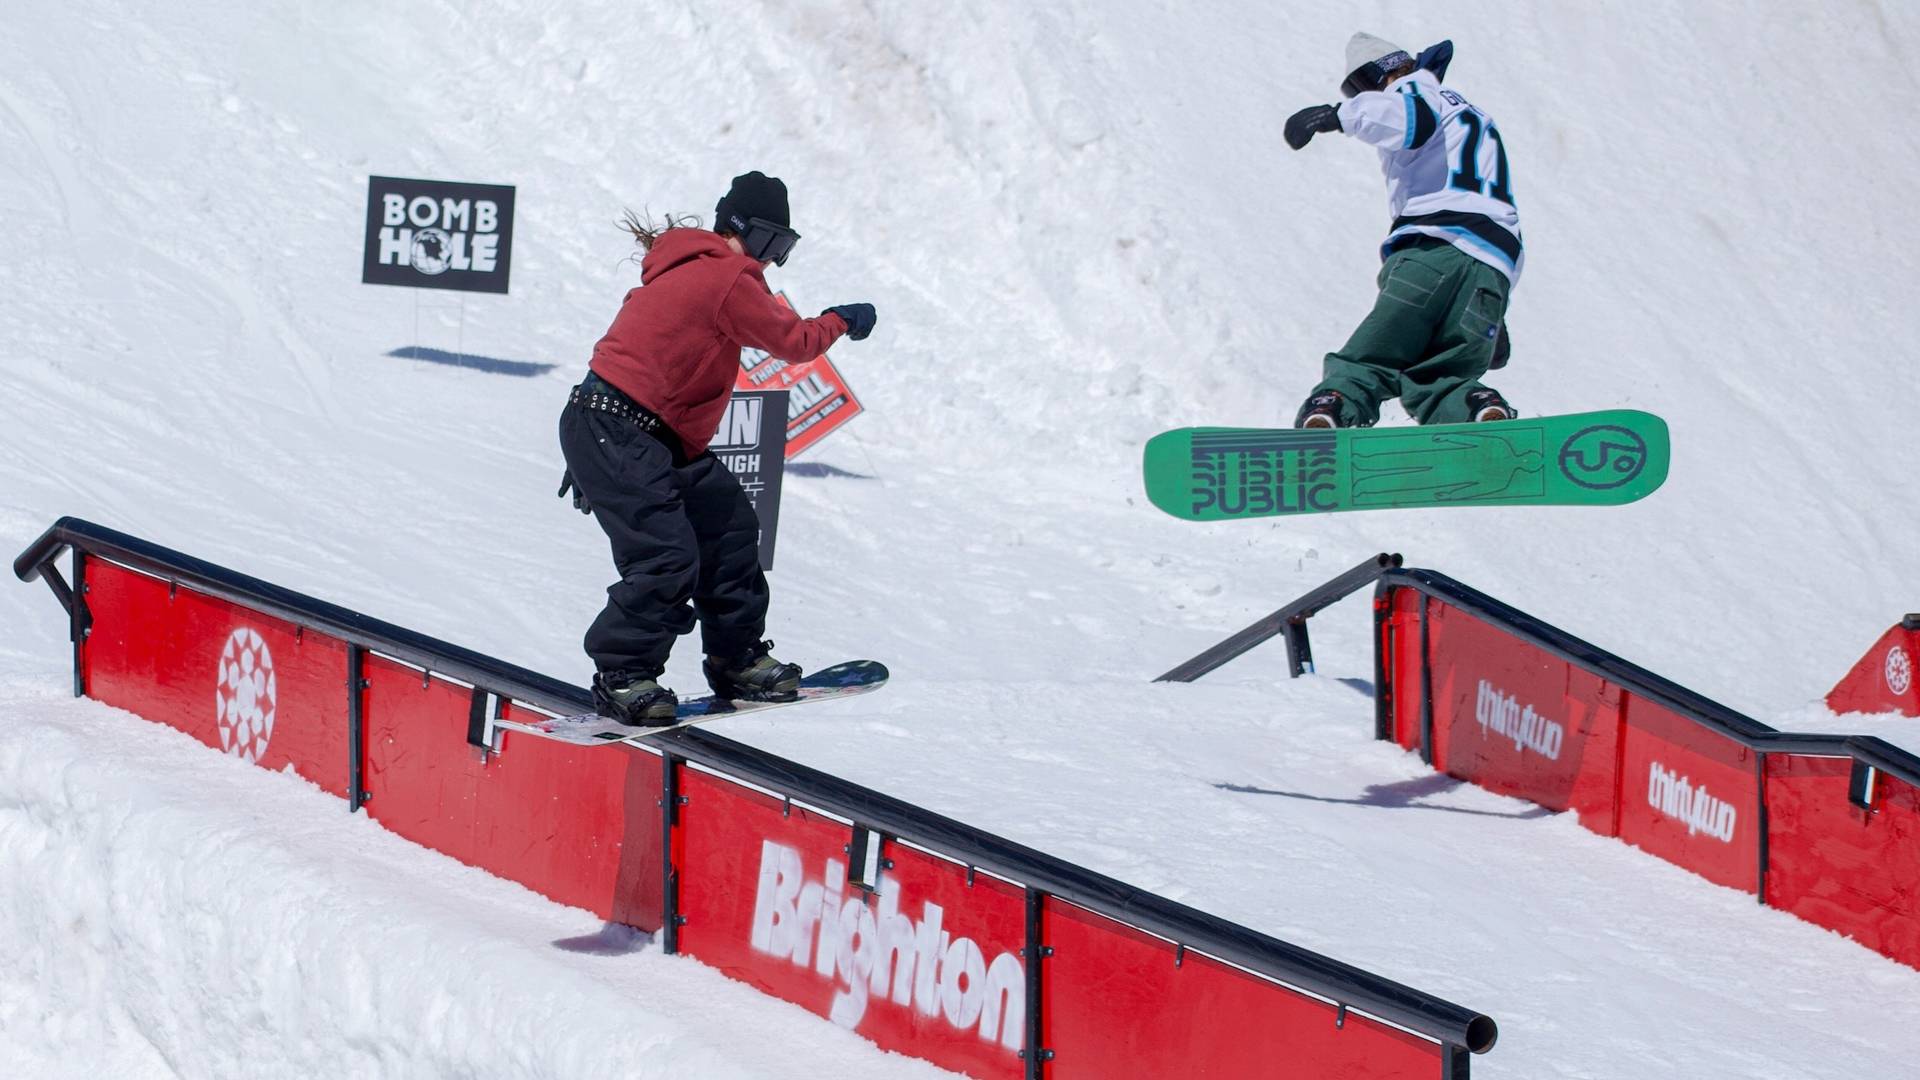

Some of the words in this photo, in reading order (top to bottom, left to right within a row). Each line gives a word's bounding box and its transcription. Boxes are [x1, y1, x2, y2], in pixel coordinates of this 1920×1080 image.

[1449, 109, 1518, 208] 11
[382, 193, 498, 233] BOMB
[378, 226, 499, 275] HOLE
[780, 371, 793, 386] A
[1191, 482, 1338, 515] PUBLIC
[1475, 678, 1564, 761] thirtytwo
[1648, 760, 1738, 844] thirtytwo
[750, 839, 1027, 1051] Brighton
